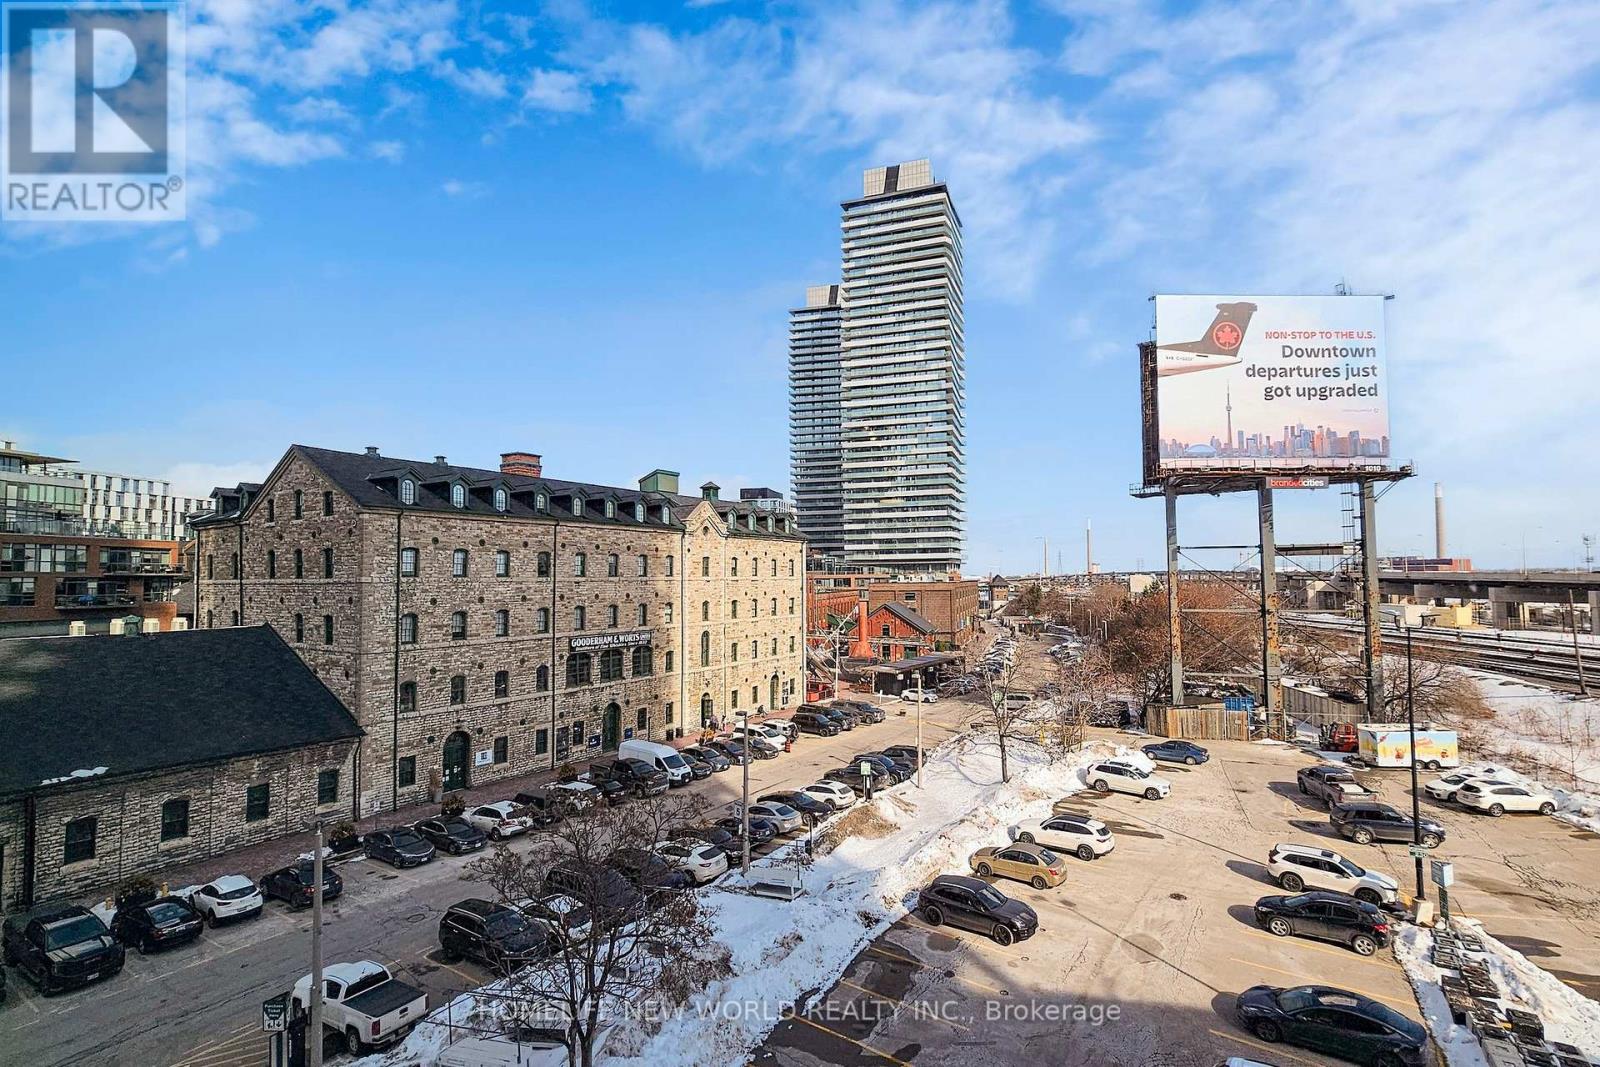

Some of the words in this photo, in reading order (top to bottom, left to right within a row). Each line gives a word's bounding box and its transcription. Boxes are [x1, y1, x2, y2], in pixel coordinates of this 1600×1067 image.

[1265, 331, 1316, 339] NON-STOP
[1319, 331, 1332, 339] TO
[1335, 331, 1354, 339] THE
[1357, 331, 1376, 339] U.S.
[1282, 344, 1376, 358] Downtown
[1246, 364, 1341, 380] departures
[1345, 364, 1377, 380] just
[1264, 384, 1291, 400] got
[1296, 383, 1378, 400] upgraded
[571, 635, 613, 648] GOODERHAM
[619, 633, 639, 642] WORTS
